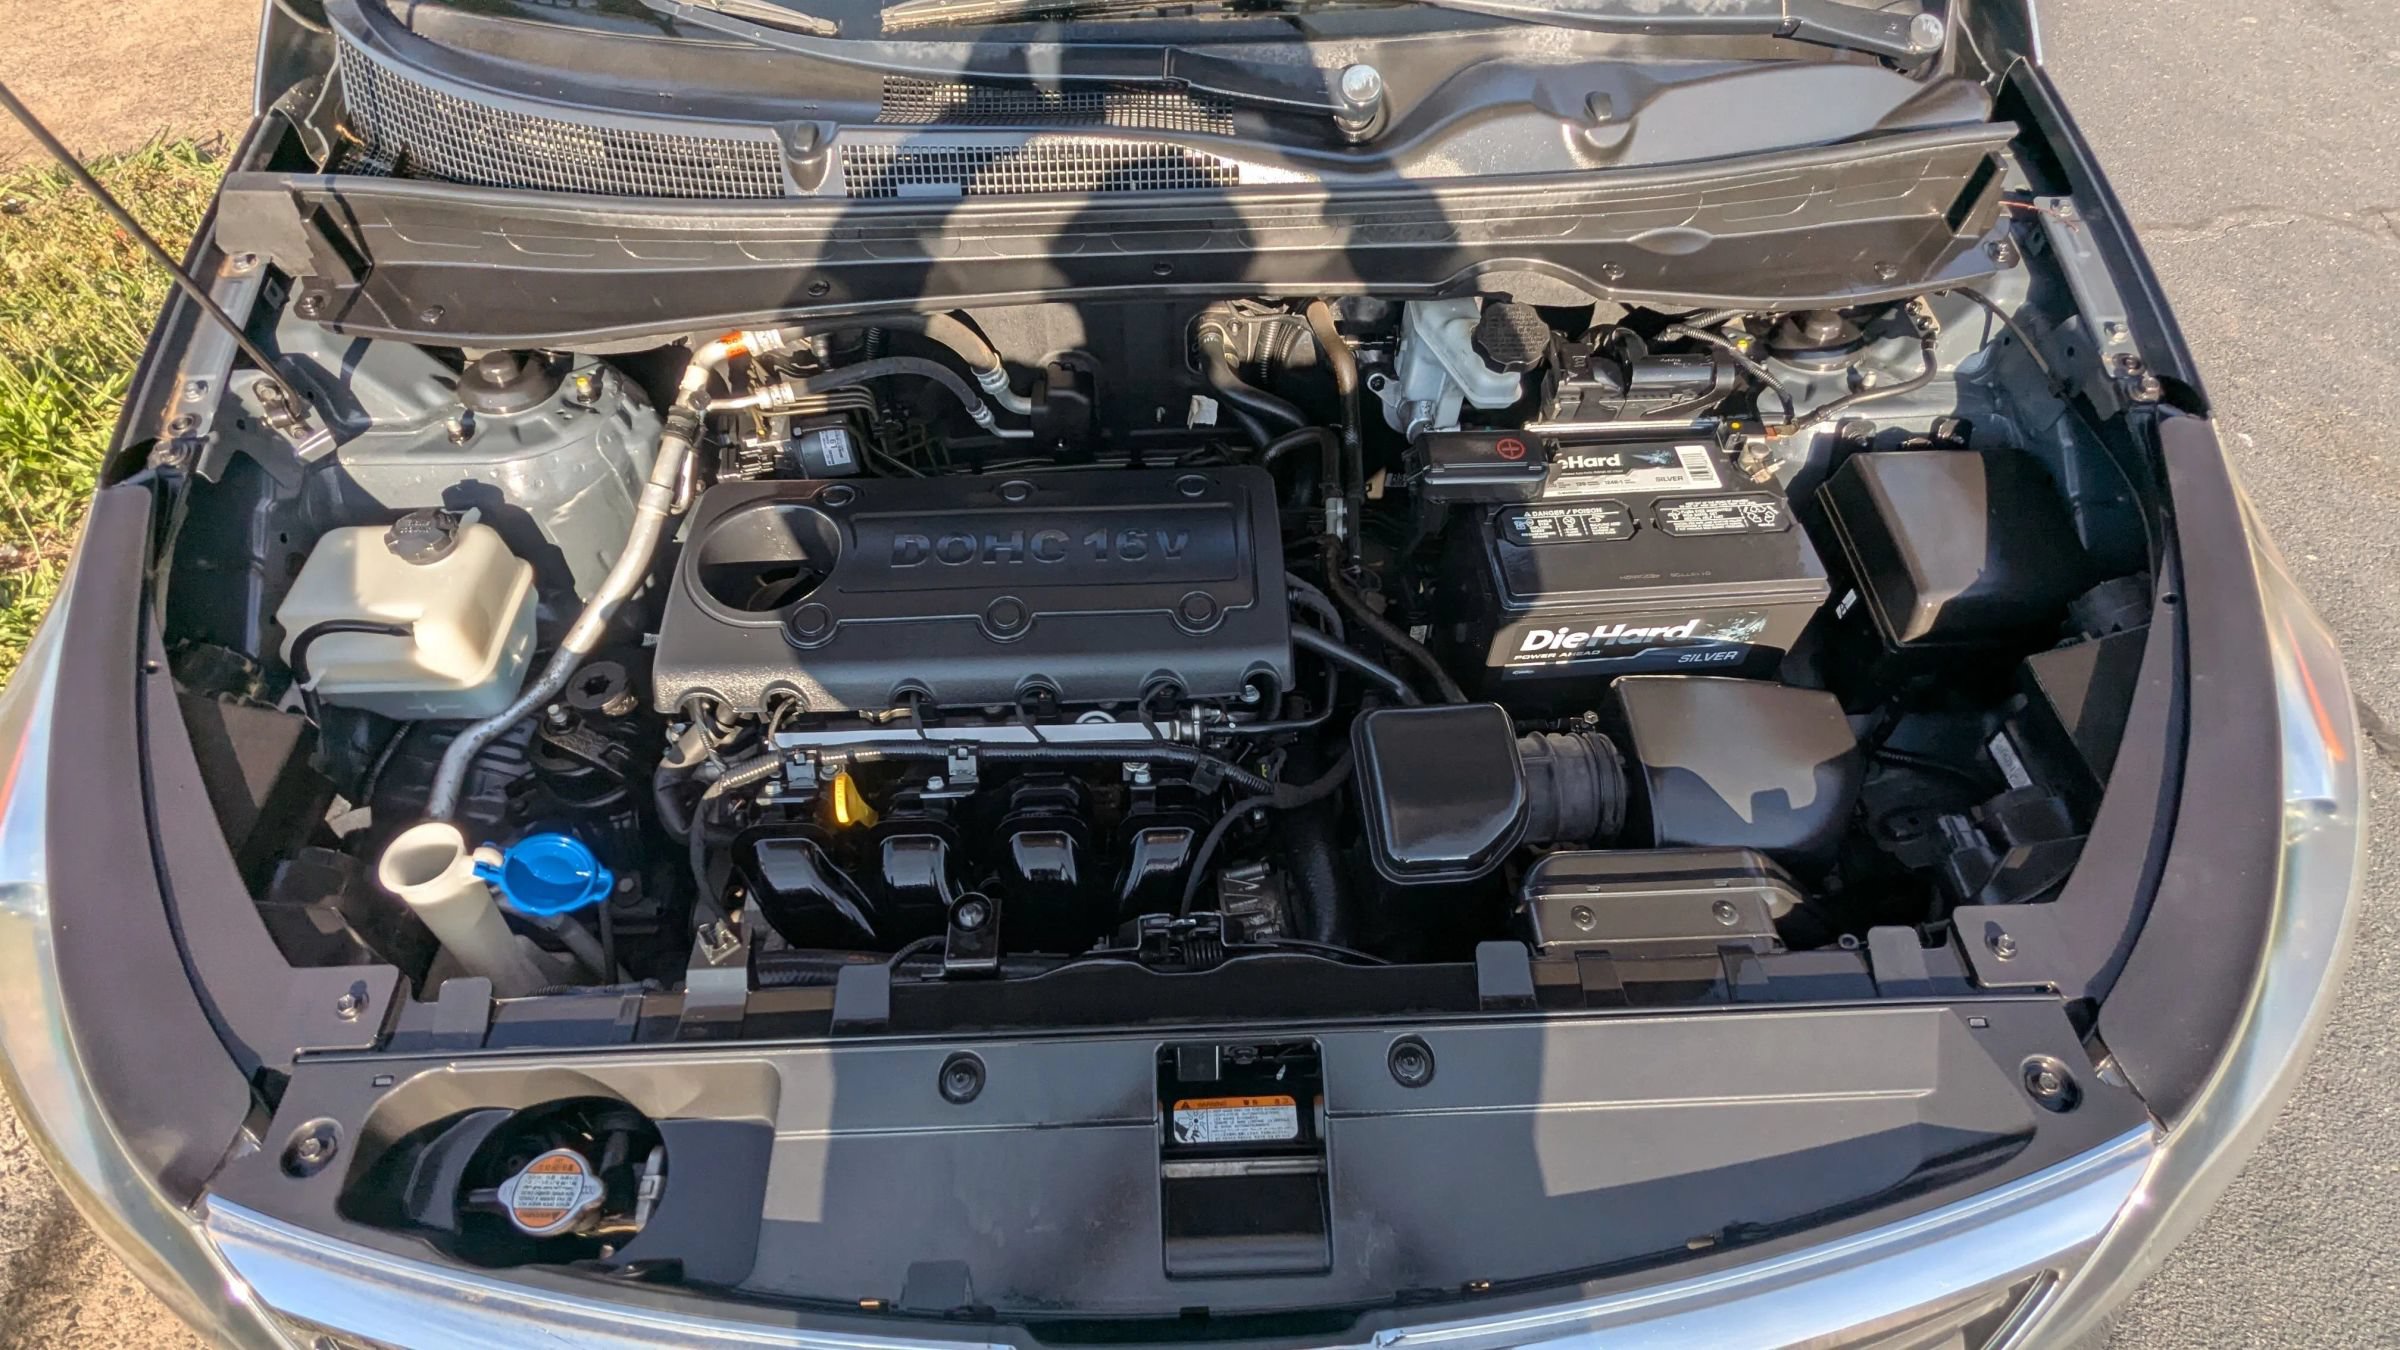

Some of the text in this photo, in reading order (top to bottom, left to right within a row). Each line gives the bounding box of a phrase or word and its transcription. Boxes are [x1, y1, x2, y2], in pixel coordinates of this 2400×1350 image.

[1556, 453, 1621, 469] eHard
[1655, 475, 1684, 483] SILVER
[1532, 509, 1565, 517] DANGER
[1572, 507, 1603, 515] POISON
[890, 528, 1189, 568] DOHC 16V
[1520, 619, 1701, 652] DieHard
[1513, 649, 1601, 661] POWER AHEAD
[1678, 650, 1739, 664] SILVER
